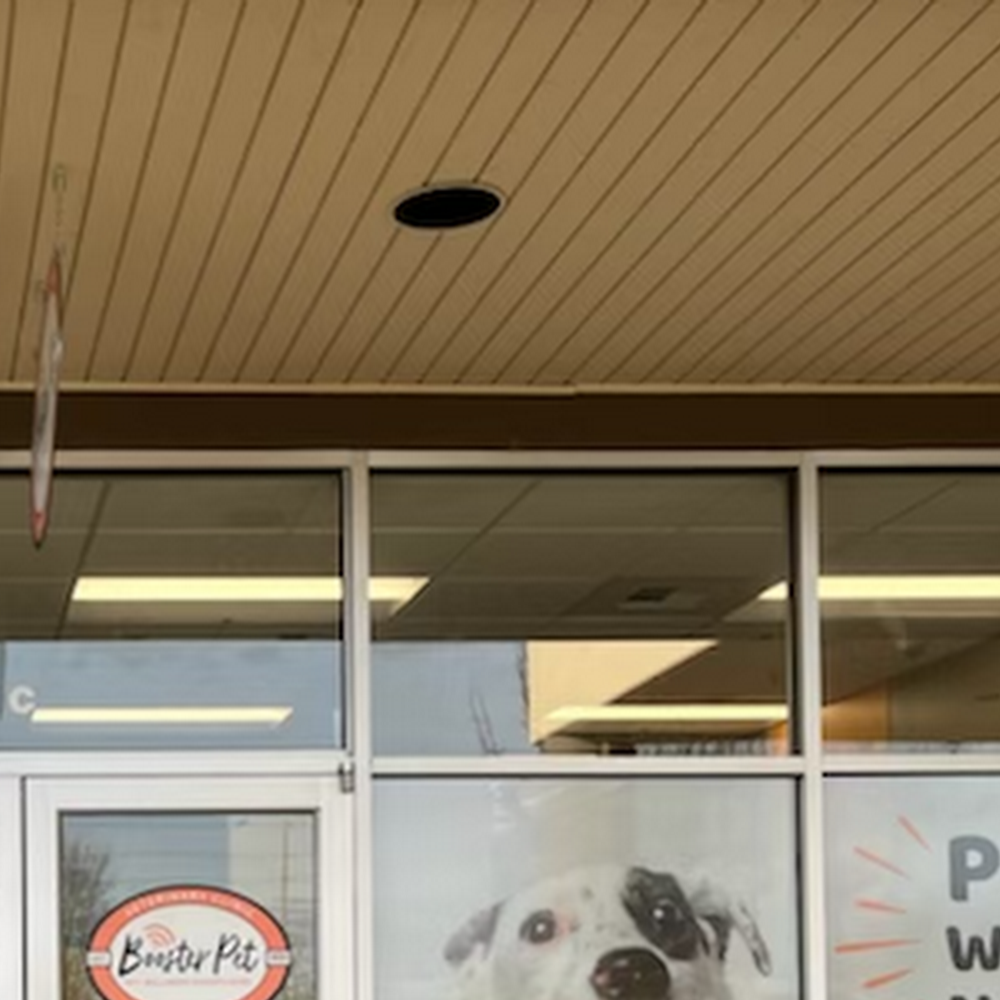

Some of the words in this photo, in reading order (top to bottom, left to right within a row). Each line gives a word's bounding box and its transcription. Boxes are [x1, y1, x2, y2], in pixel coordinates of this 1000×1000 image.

[9, 685, 36, 714] C
[949, 834, 1000, 902] P
[118, 934, 211, 977] Booster
[212, 932, 260, 975] Pet
[946, 926, 1000, 972] W
